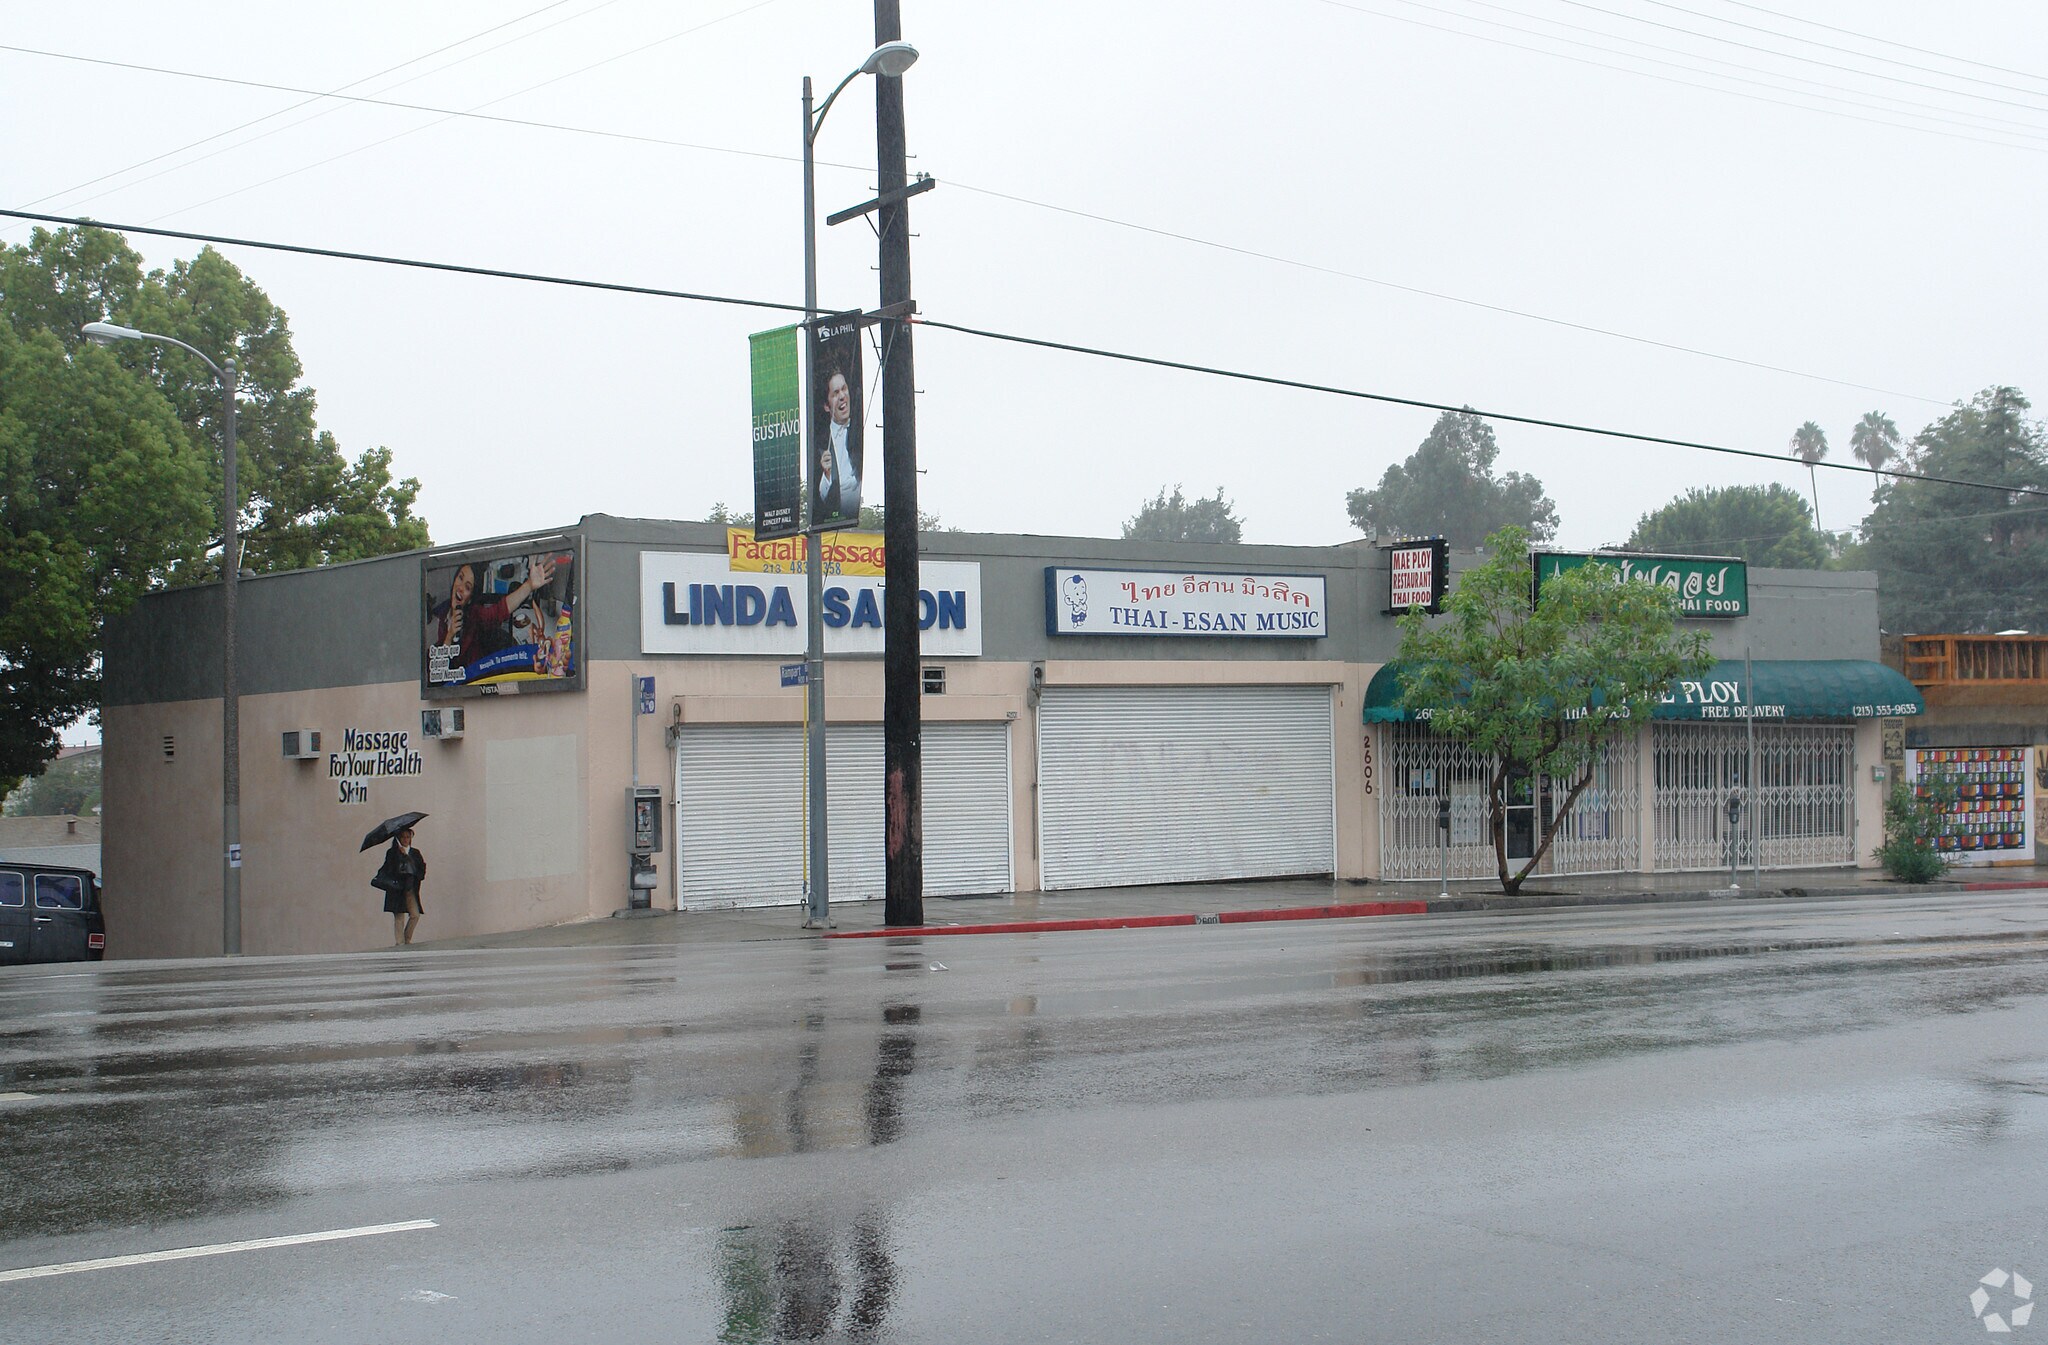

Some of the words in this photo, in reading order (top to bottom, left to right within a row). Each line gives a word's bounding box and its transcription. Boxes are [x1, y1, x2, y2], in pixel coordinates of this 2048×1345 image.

[753, 419, 800, 442] GUSTAVO
[732, 534, 796, 560] Facial
[763, 563, 782, 574] 213
[1393, 552, 1410, 570] MAE
[1412, 550, 1431, 569] PLOY
[1393, 571, 1431, 590] RESTAURANT
[662, 581, 797, 627] LINDA
[1121, 581, 1175, 604] ไทย
[1393, 592, 1410, 605] THAI
[1412, 590, 1431, 604] FOOD
[1706, 600, 1741, 612] FOOD
[1256, 611, 1320, 631] MUSIC
[1680, 681, 1741, 704] PLOY
[1702, 706, 1731, 718] FREE
[1852, 704, 1874, 717] (213)
[1876, 703, 1917, 716] 353-9635
[343, 728, 408, 755] Massage
[329, 753, 347, 777] For
[347, 752, 377, 776] Your
[377, 748, 422, 776] Health
[1363, 735, 1373, 795] 2606
[339, 780, 367, 803] Skin
